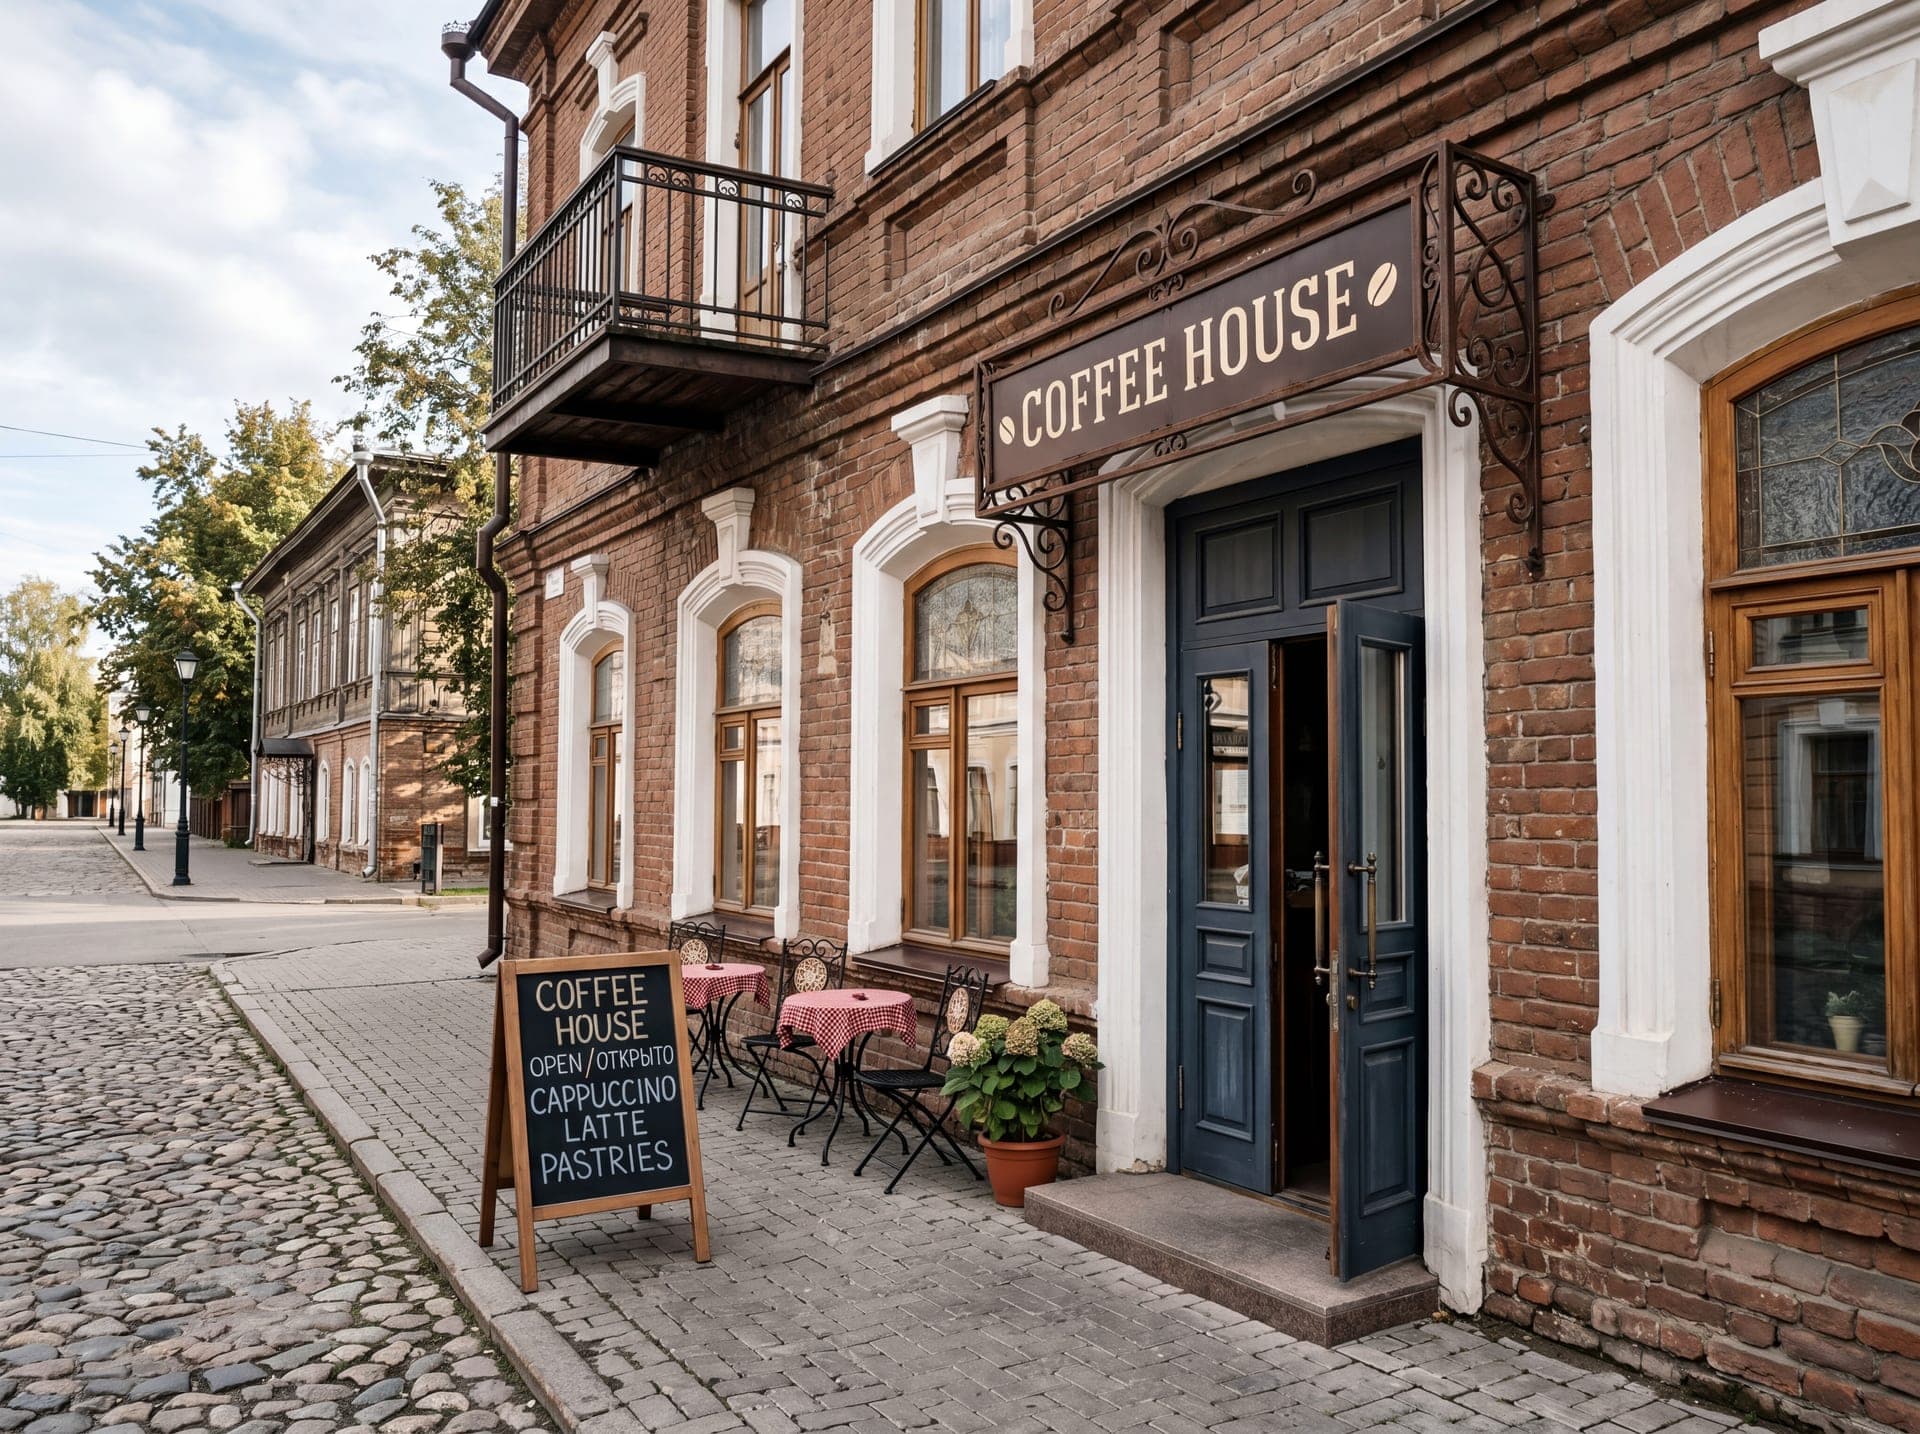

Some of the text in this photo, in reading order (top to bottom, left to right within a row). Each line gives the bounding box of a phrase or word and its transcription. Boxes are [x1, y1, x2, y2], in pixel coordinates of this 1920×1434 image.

[1022, 260, 1358, 448] COFFEE HOUSE
[536, 973, 648, 1012] COFFEE
[556, 1010, 649, 1046] HOUSE
[530, 1075, 676, 1115] CAPPUCCINO
[564, 1110, 648, 1143] LATTE
[541, 1140, 673, 1185] PASTRIES
